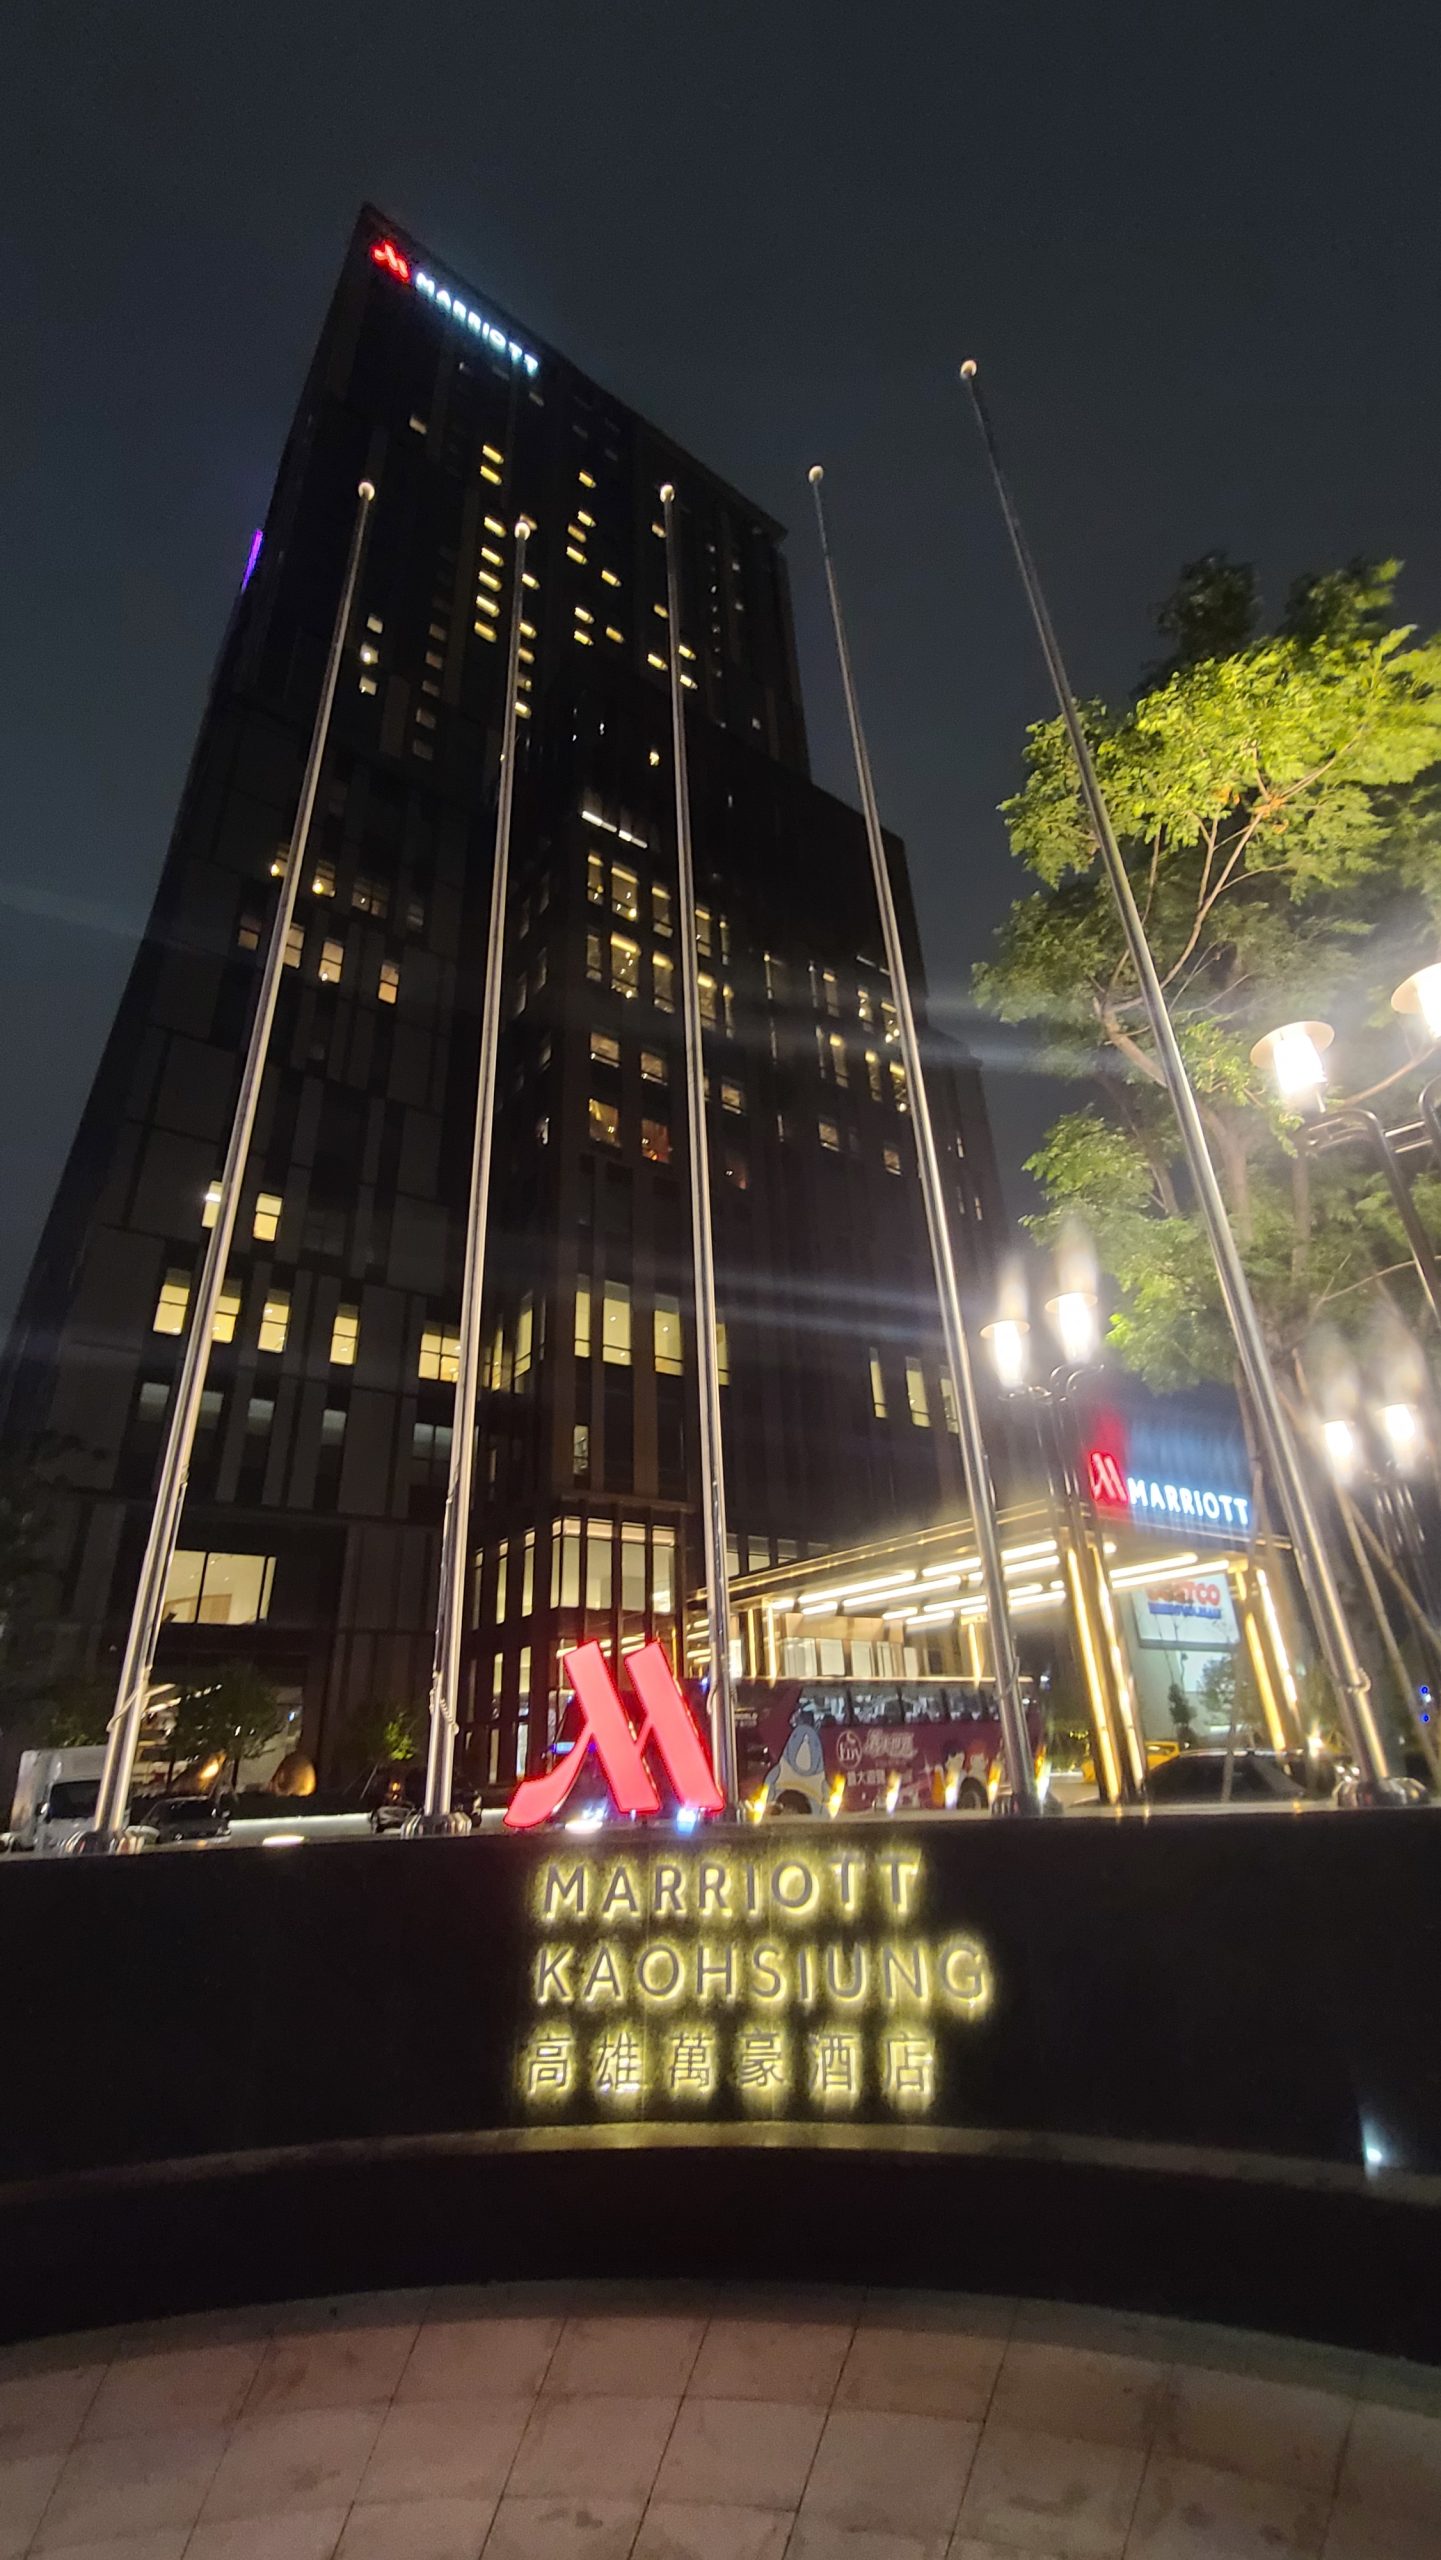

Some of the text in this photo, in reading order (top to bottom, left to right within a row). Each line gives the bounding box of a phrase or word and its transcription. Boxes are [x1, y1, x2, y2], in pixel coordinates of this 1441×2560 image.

[416, 272, 539, 376] MARRIOTT
[1127, 1476, 1249, 1525] MARRIOTT
[542, 1849, 922, 1916] MARRIOTT
[535, 1941, 988, 2004] KAOHSIUNG
[526, 2027, 935, 2093] 高雄萬豪酒店
